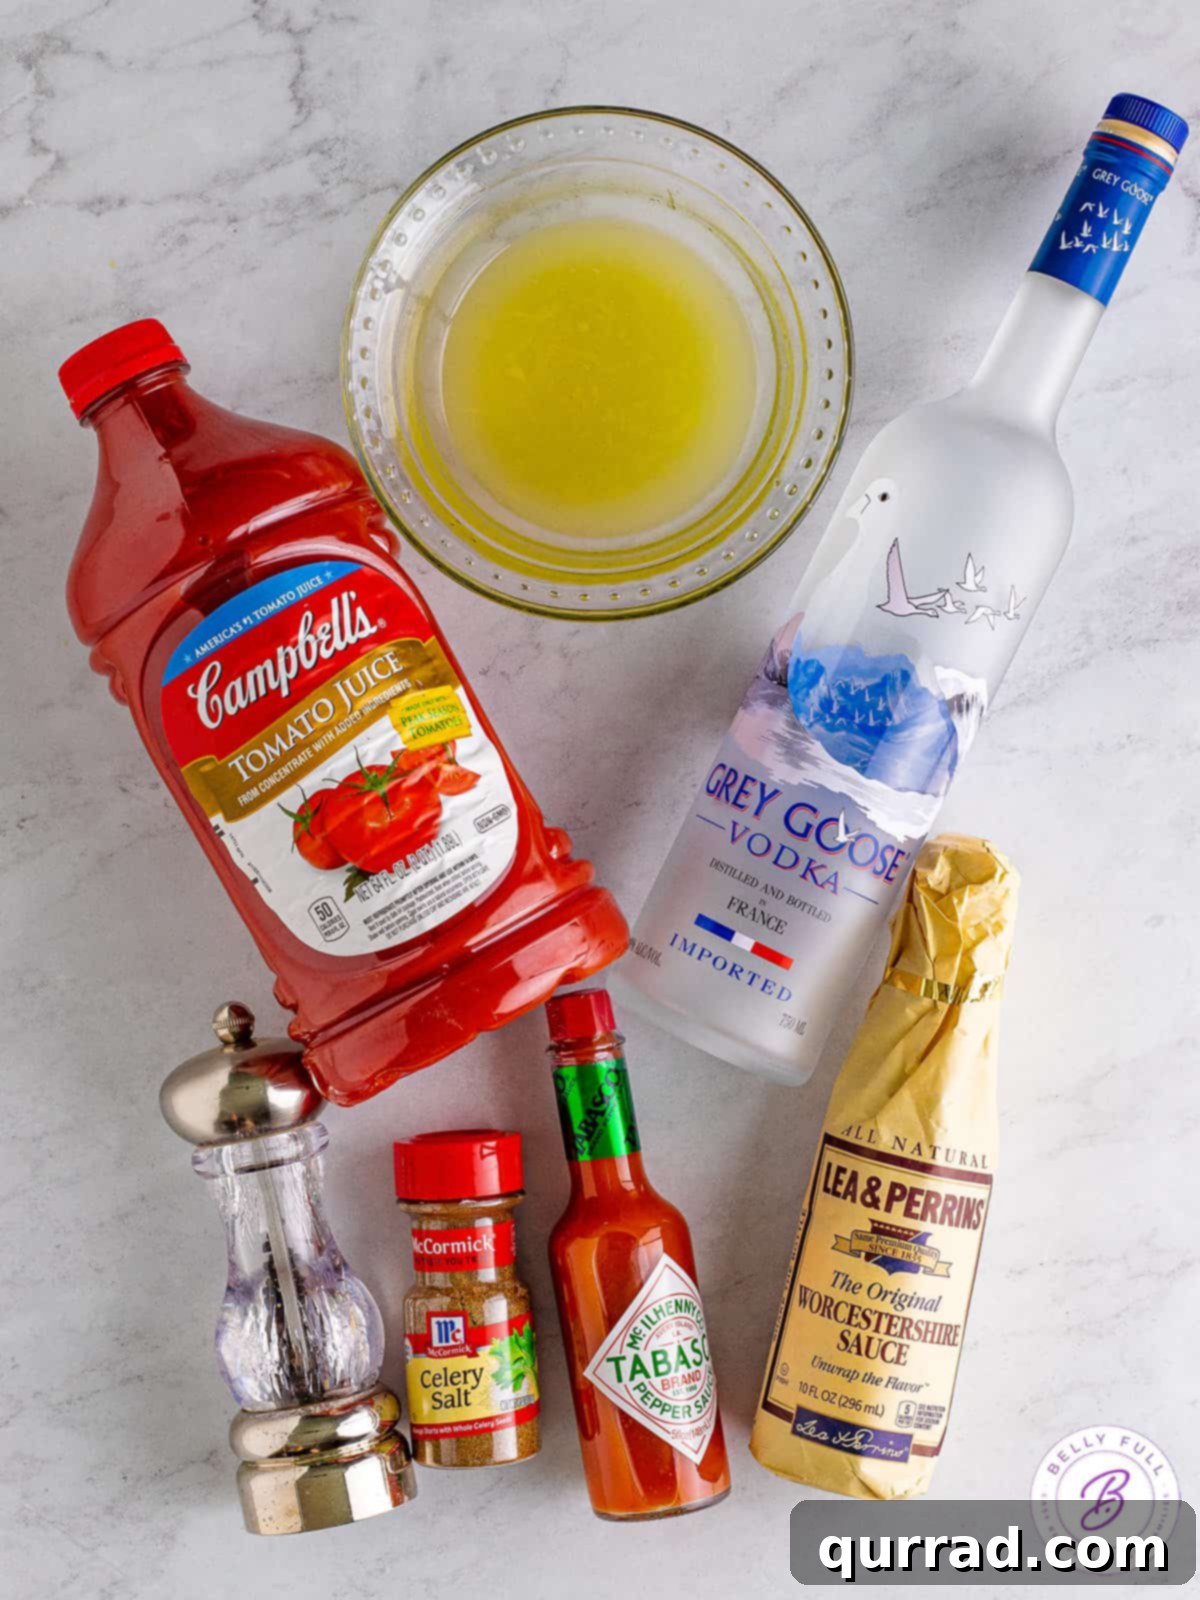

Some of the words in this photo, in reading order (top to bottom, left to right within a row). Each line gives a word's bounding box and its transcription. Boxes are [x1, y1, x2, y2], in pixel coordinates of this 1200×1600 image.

[1092, 168, 1120, 187] GREY
[1121, 180, 1152, 205] GOOSE
[194, 621, 243, 660] AMERICA'S
[241, 616, 252, 628] #1
[252, 590, 297, 622] TOMATO
[295, 575, 325, 601] JUICE
[187, 591, 376, 730] Campbell's
[228, 697, 337, 784] TOMATO
[336, 650, 405, 714] JUICE
[237, 786, 263, 808] FROM
[258, 747, 316, 796] CONCENTRATE
[313, 729, 337, 754] WITH
[334, 711, 363, 740] ADDED
[360, 679, 413, 717] INGREDIENTS
[705, 763, 783, 820] GREY
[783, 802, 906, 885] GOOSE
[730, 820, 840, 895] VODKA
[710, 857, 760, 889] DISTILLED
[761, 883, 785, 901] AND
[786, 894, 832, 924] BOTTLED
[314, 902, 334, 921] 50
[727, 896, 788, 935] FRANCE
[669, 932, 792, 1003] IMPORTED
[841, 1125, 877, 1145] ALL
[891, 1135, 989, 1170] NATURAL
[867, 1243, 899, 1258] SINCE
[831, 1270, 863, 1295] The
[866, 1281, 942, 1313] Original
[641, 1298, 697, 1331] ILHENNY
[798, 1284, 961, 1347] WORCESTERSHIRE
[606, 1334, 711, 1384] TABASC
[836, 1329, 910, 1366] SAUCE
[420, 1366, 484, 1391] Celery
[661, 1369, 702, 1392] BRAND
[810, 1354, 860, 1382] Unwrap
[861, 1369, 882, 1388] the
[431, 1388, 472, 1411] Salt
[633, 1382, 692, 1419] PEPPER
[798, 1381, 809, 1395] 10
[807, 1384, 818, 1399] FL
[820, 1388, 838, 1404] OZ
[837, 1393, 863, 1413] (296
[864, 1402, 885, 1419] mL)
[903, 1403, 911, 1416] 5
[796, 1419, 828, 1441] Lea
